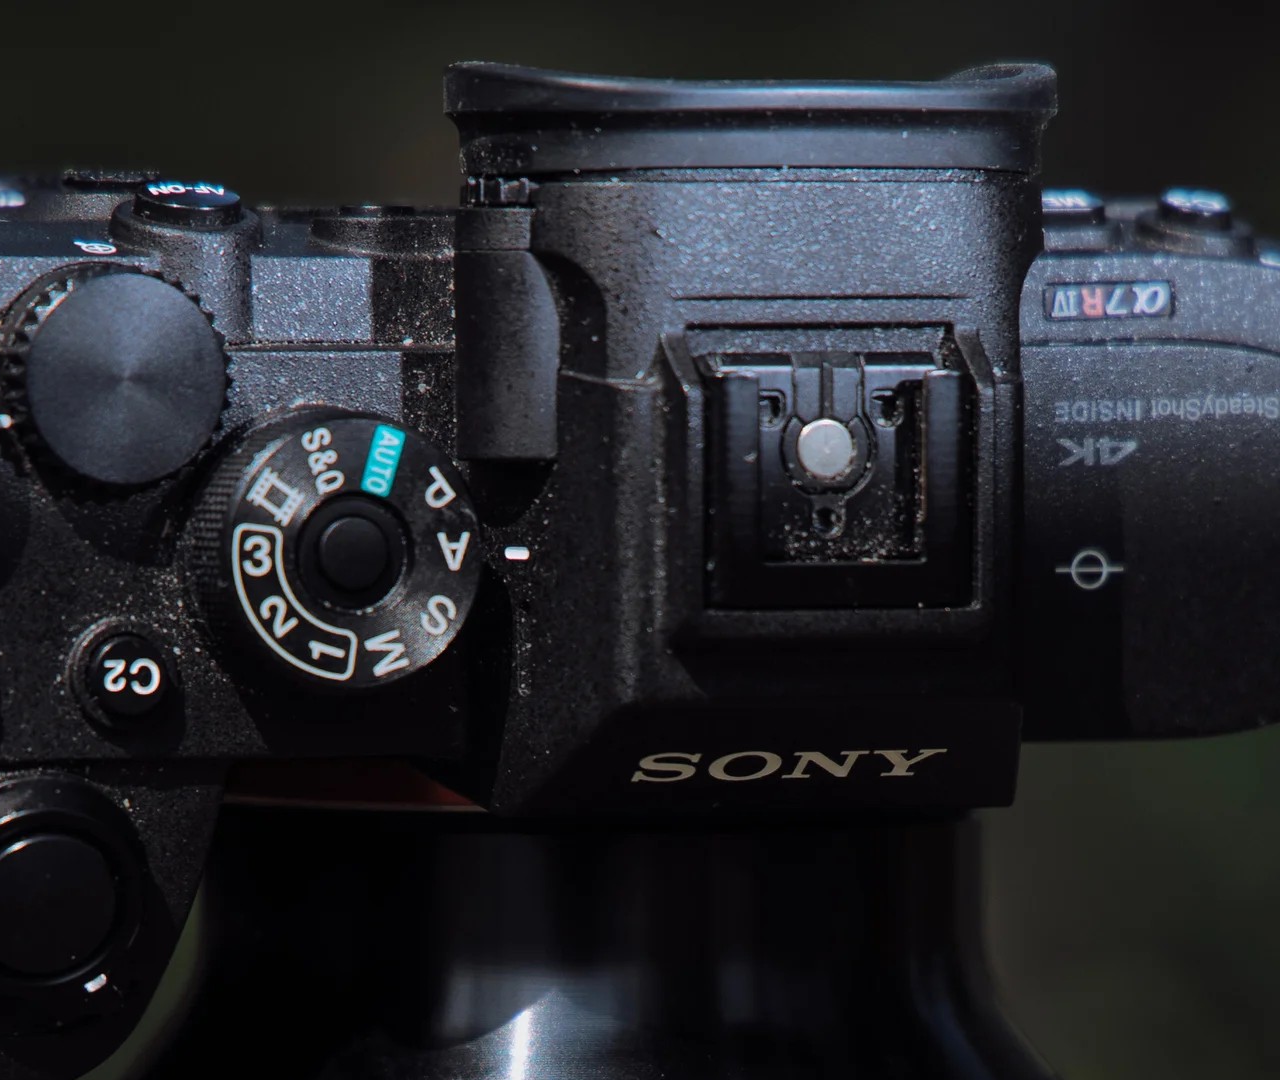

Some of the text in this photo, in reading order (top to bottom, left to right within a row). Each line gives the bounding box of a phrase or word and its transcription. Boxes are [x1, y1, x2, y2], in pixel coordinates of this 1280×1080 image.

[148, 181, 225, 196] AF-ON
[1054, 396, 1280, 422] SteadyShot INSIDE
[301, 426, 345, 495] S&Q
[363, 430, 402, 495] AUTO
[1056, 437, 1138, 466] 4K
[424, 465, 457, 510] P
[241, 536, 274, 578] 3
[437, 531, 470, 572] A
[259, 595, 300, 639] 2
[420, 594, 458, 637] S
[308, 639, 346, 662] 1
[364, 629, 410, 678] M
[103, 657, 162, 695] C2
[631, 749, 948, 782] SONY
